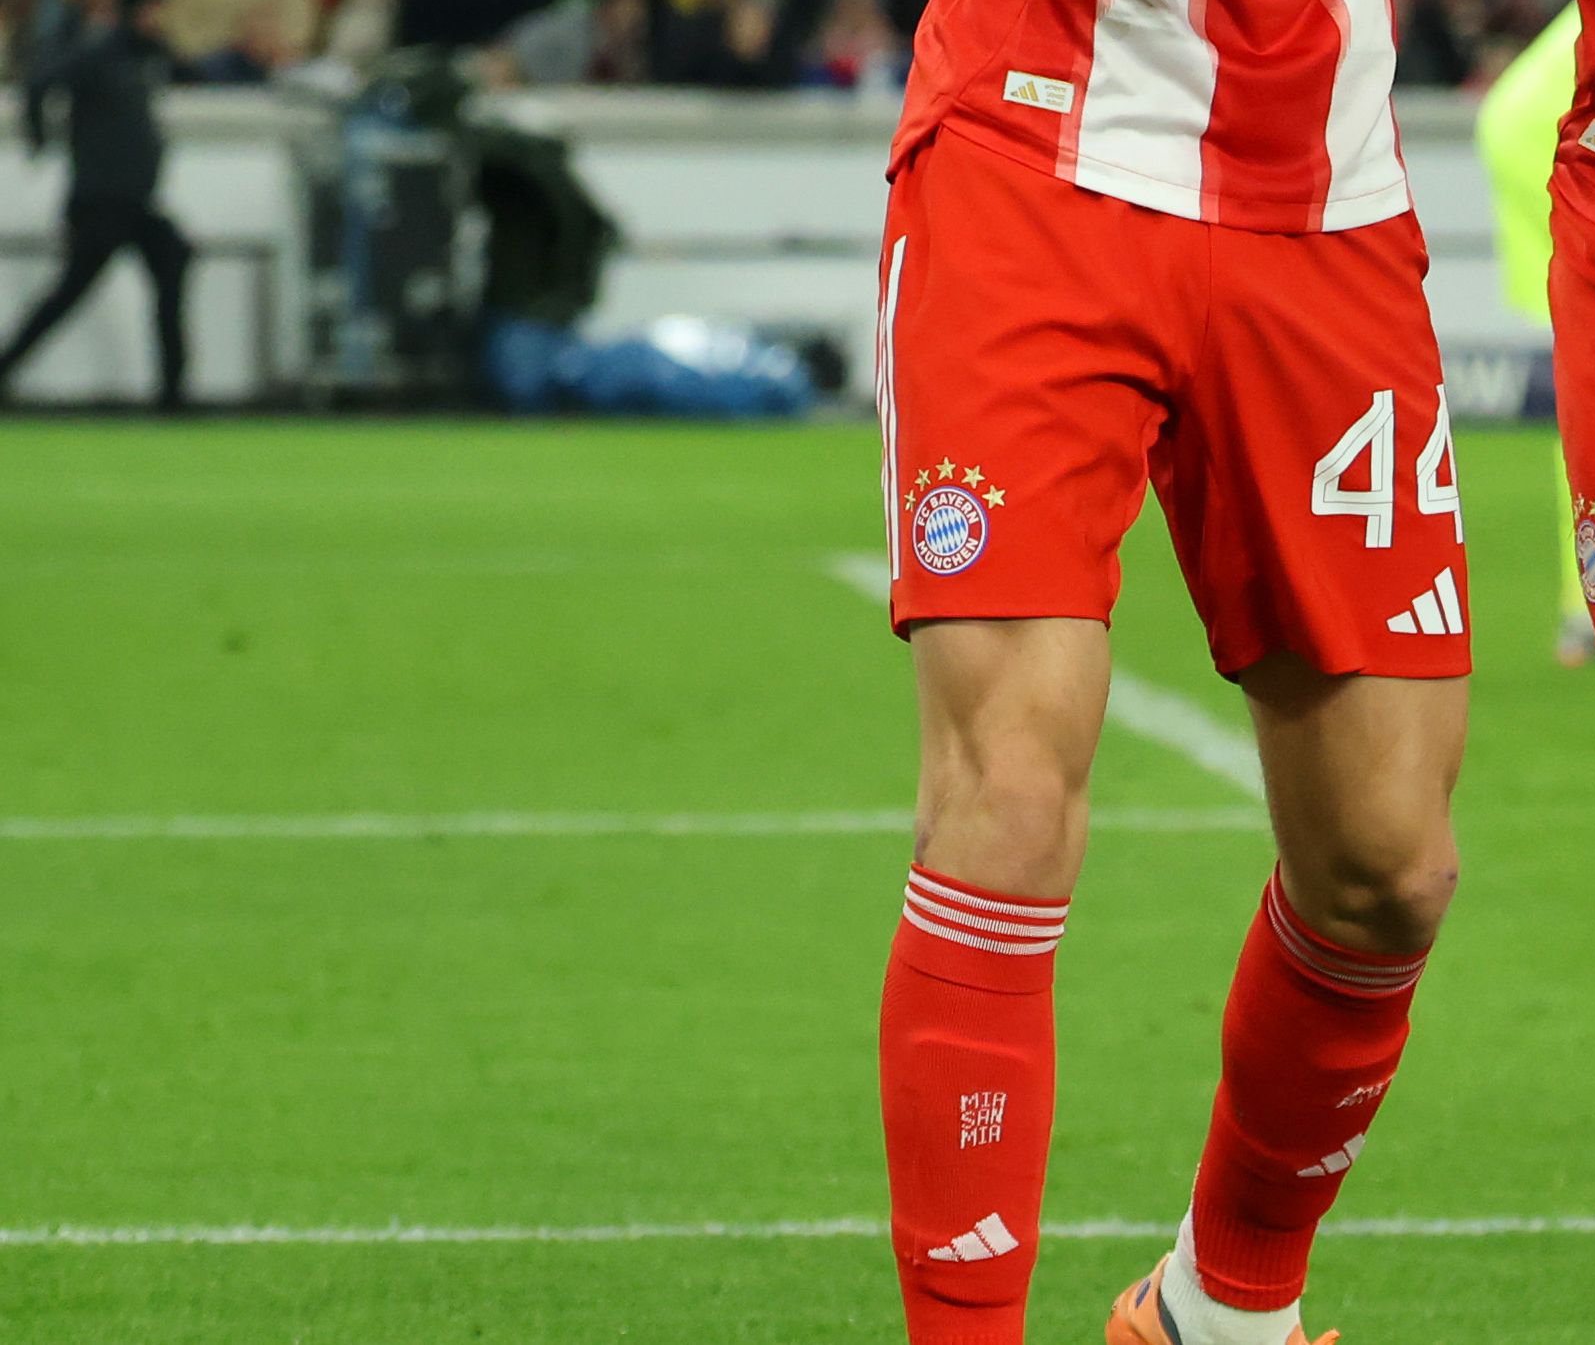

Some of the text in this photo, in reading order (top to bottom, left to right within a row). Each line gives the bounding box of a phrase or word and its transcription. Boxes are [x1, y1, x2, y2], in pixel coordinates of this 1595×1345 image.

[1311, 384, 1465, 549] 44
[917, 493, 979, 526] FC BAYERN
[960, 1092, 1007, 1112] MIA
[961, 1108, 1003, 1129] SAN
[960, 1125, 1001, 1149] MIA
